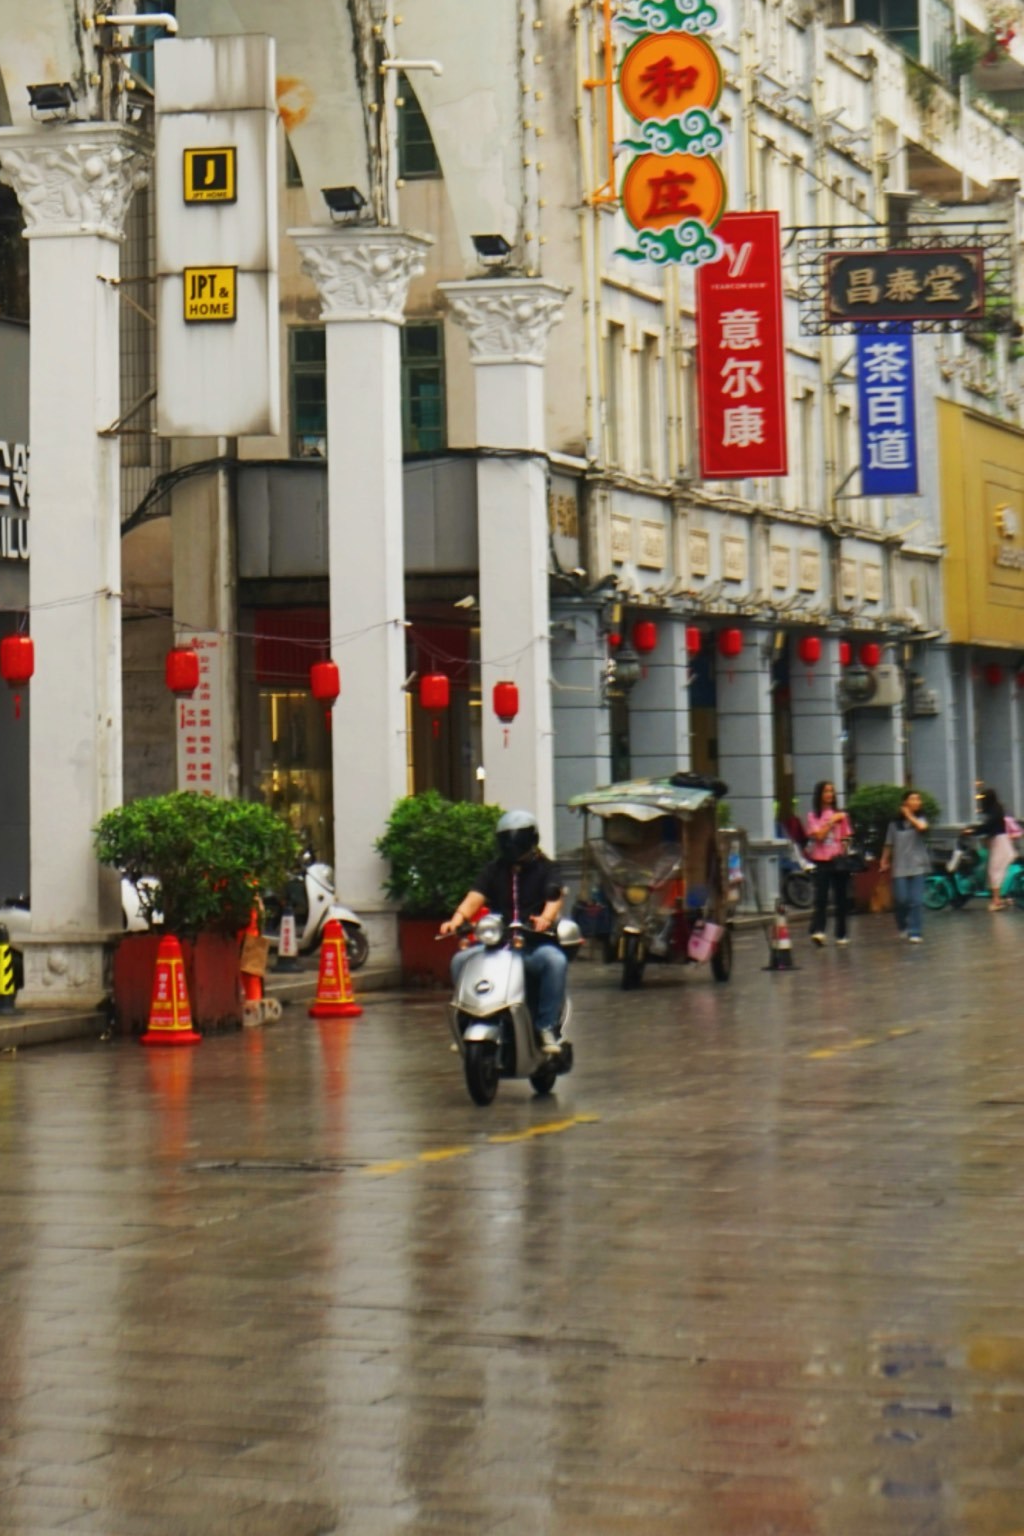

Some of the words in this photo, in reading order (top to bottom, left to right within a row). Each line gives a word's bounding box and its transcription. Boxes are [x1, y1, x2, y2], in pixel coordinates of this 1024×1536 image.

[204, 159, 215, 185] J
[206, 191, 227, 199] HOME
[190, 274, 217, 301] JPT
[189, 303, 229, 315] HOME
[718, 308, 765, 448] 意尔康
[863, 341, 911, 470] 茶百道
